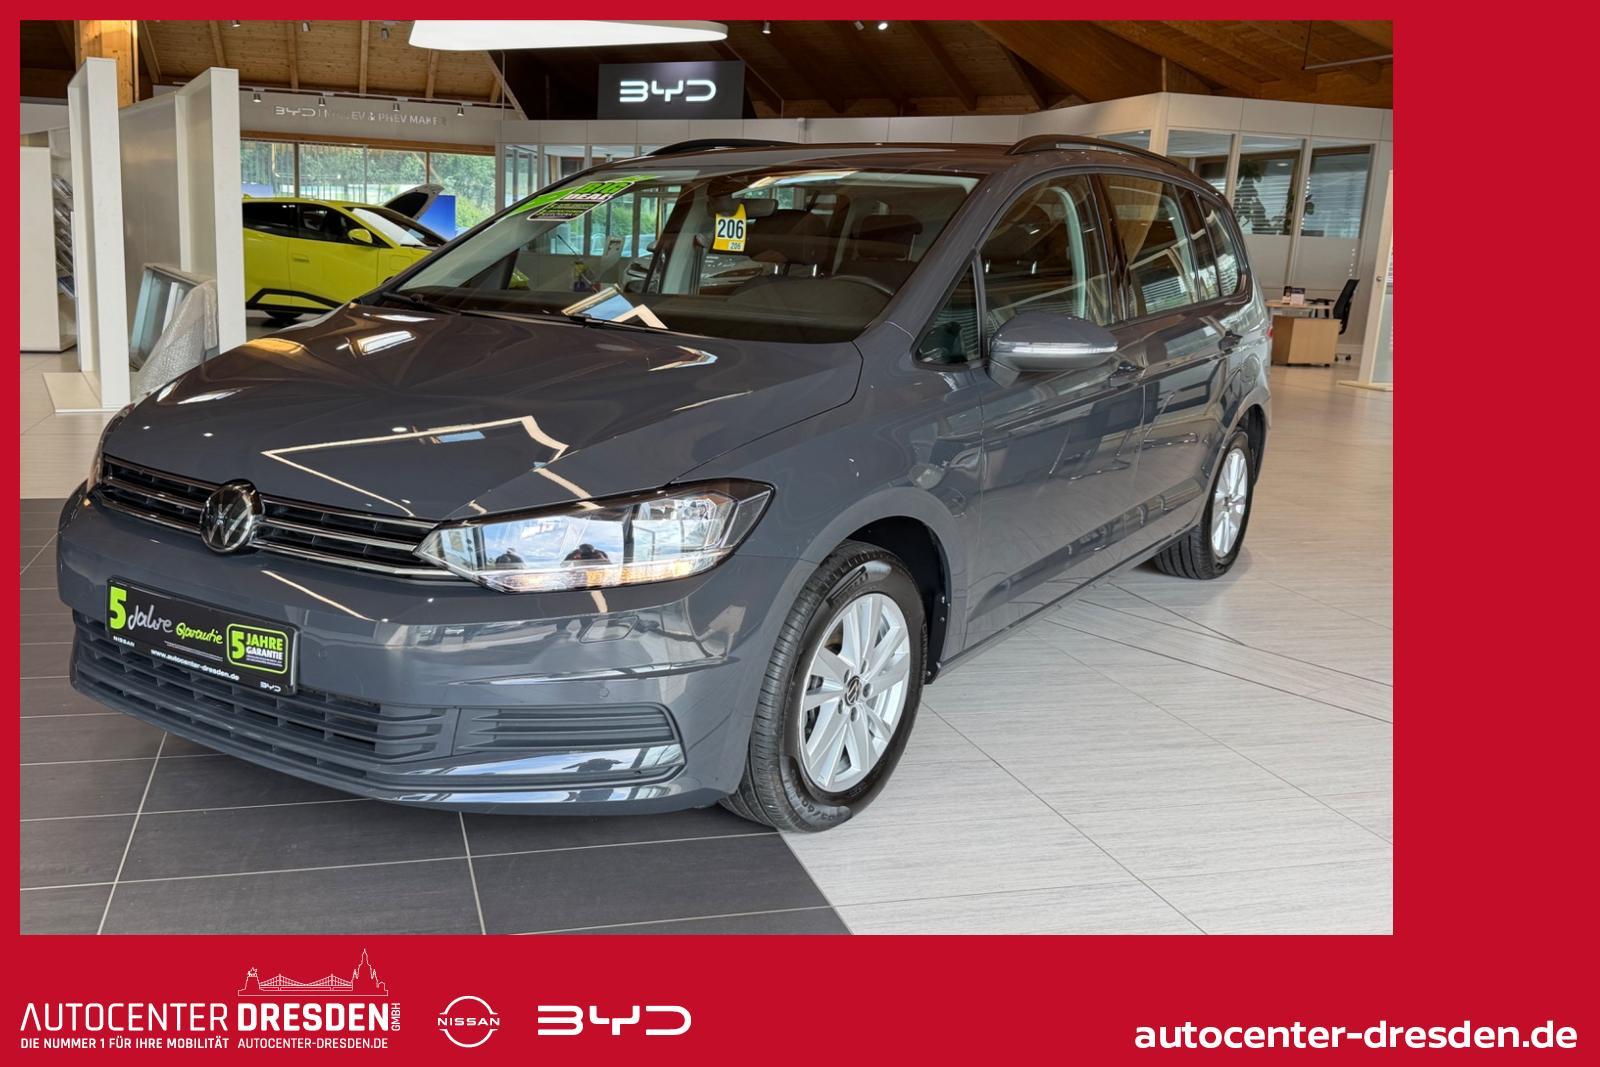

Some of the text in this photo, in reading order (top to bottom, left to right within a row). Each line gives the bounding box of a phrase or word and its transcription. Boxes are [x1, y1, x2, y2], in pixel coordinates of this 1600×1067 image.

[619, 80, 717, 103] BYD
[275, 105, 316, 117] BYD
[718, 219, 744, 239] 206
[109, 586, 224, 645] 5 Jahre Garantie
[112, 635, 135, 647] NISSAN
[231, 630, 245, 660] 5
[246, 633, 283, 651] JAHRE
[246, 646, 283, 660] GARANTIE
[150, 649, 240, 681] www.autocenter-dresden.de
[260, 681, 281, 692] BYD
